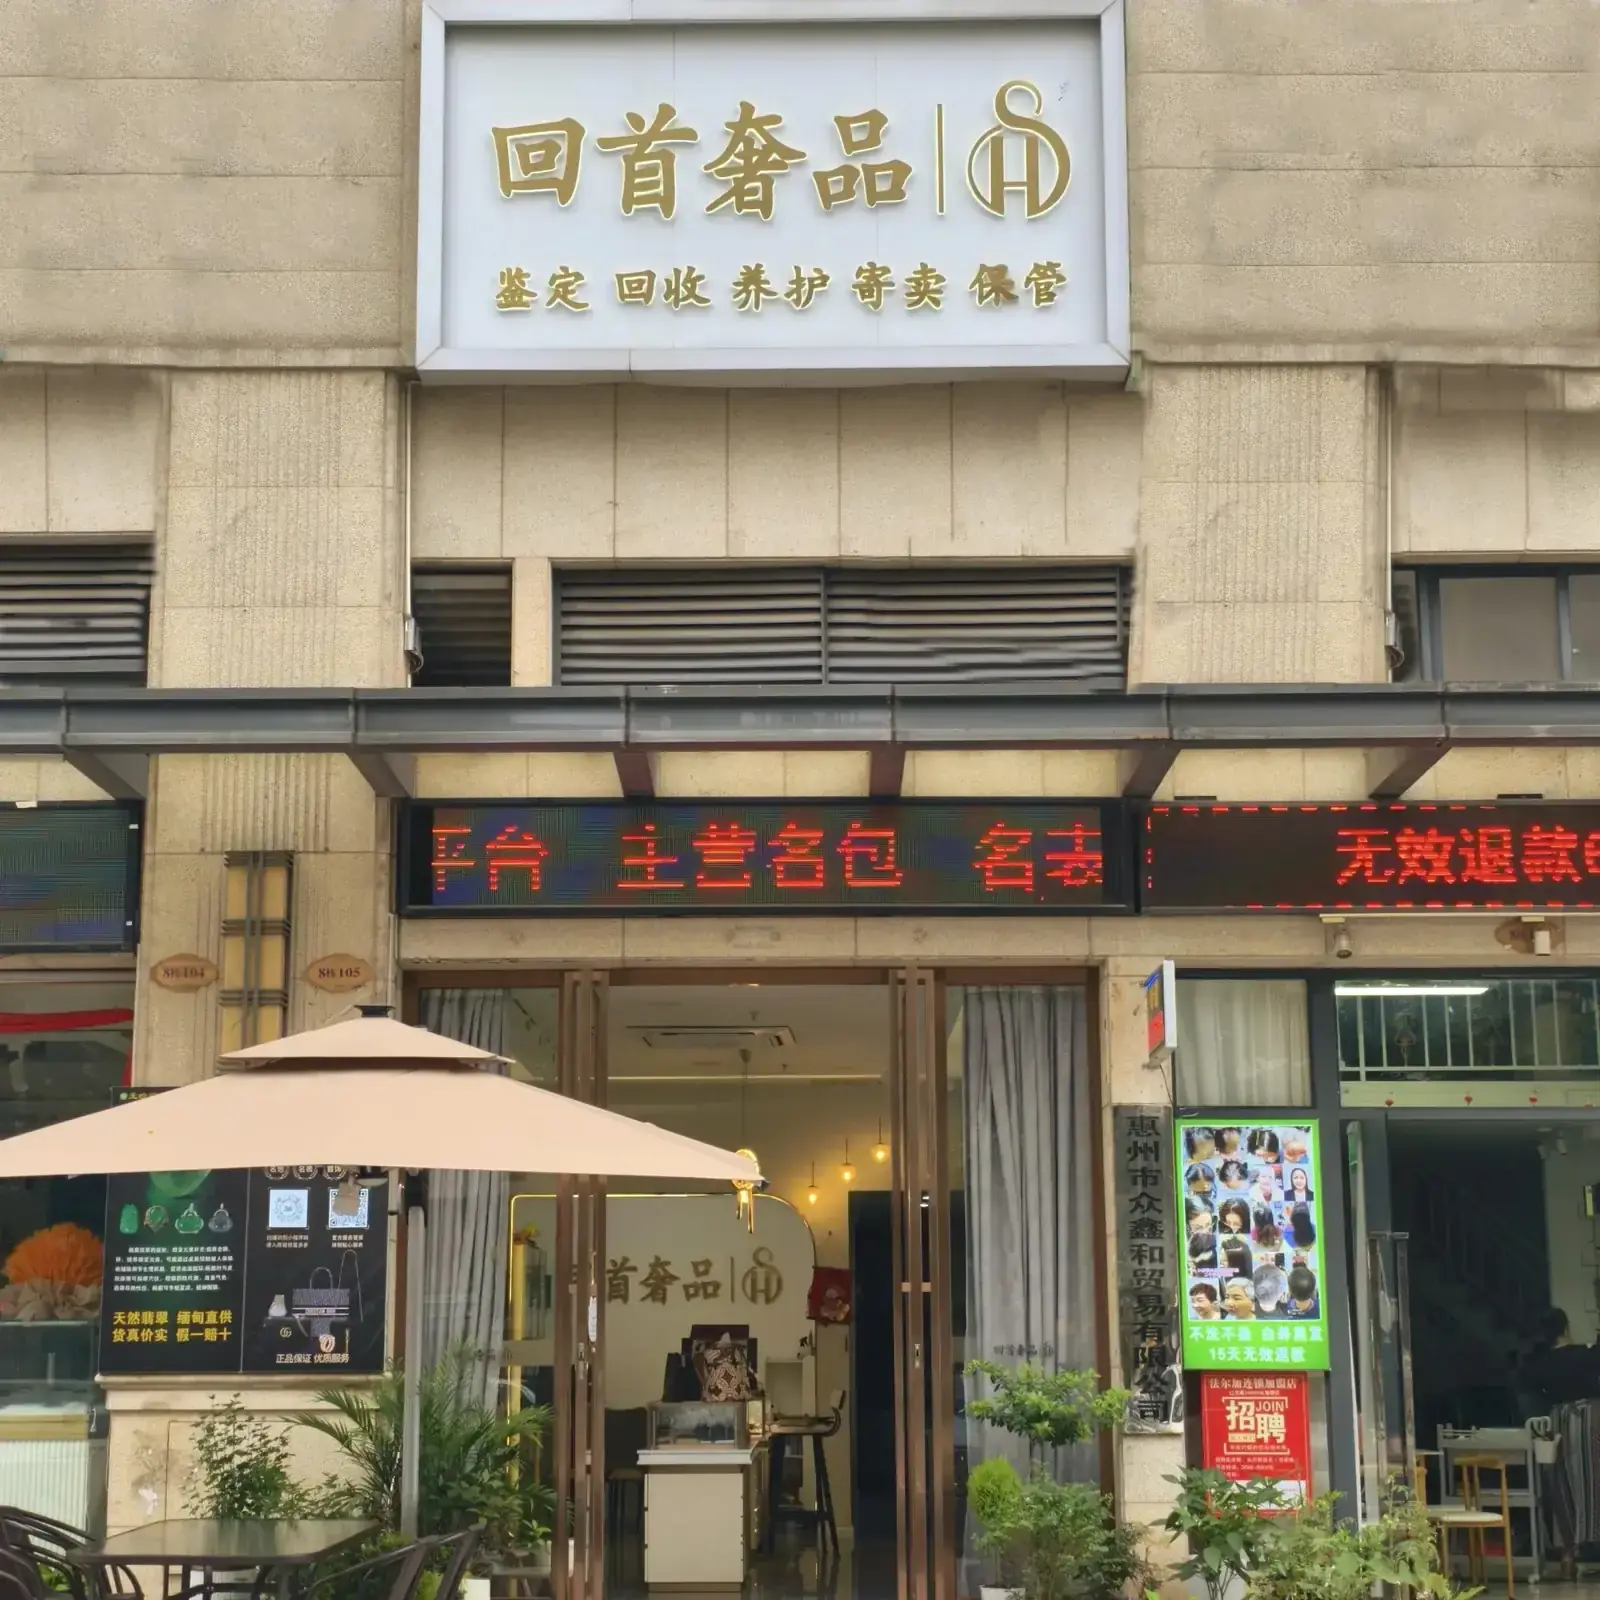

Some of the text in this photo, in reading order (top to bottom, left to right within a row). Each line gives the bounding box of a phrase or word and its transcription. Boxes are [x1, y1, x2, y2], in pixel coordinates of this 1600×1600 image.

[491, 101, 912, 220] 回首奢品
[495, 262, 1067, 312] 鉴定 回收 养护 寄卖 保管
[617, 823, 904, 890] 主营名包
[1336, 825, 1600, 884] 无效退款
[112, 1327, 232, 1342] 货真价实 假一赔十
[113, 1310, 233, 1325] 天然翡翠 缅甸直供
[275, 1354, 312, 1363] 正品保证
[1226, 1400, 1286, 1443] 招聘
[1255, 1401, 1285, 1413] JOIN
